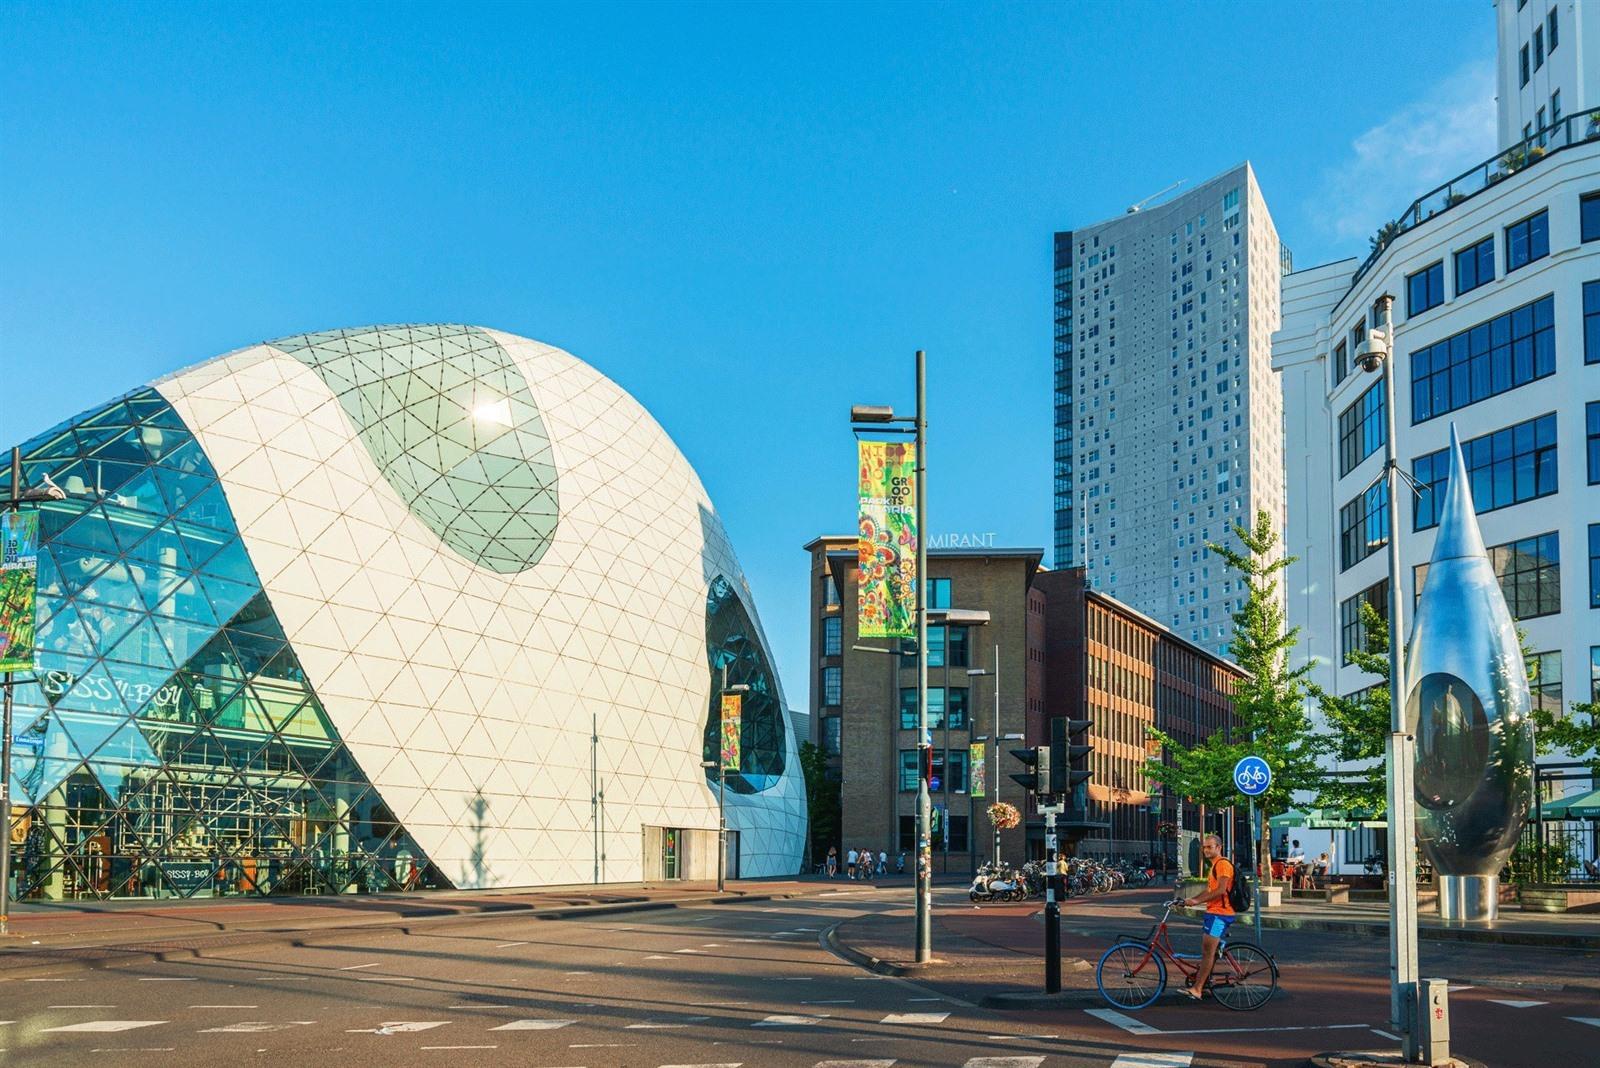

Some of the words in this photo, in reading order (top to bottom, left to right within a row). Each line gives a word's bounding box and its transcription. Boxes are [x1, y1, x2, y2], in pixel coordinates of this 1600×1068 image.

[891, 477, 908, 486] GR
[891, 487, 910, 496] OO
[892, 496, 904, 505] TS
[927, 532, 997, 548] MIRANT
